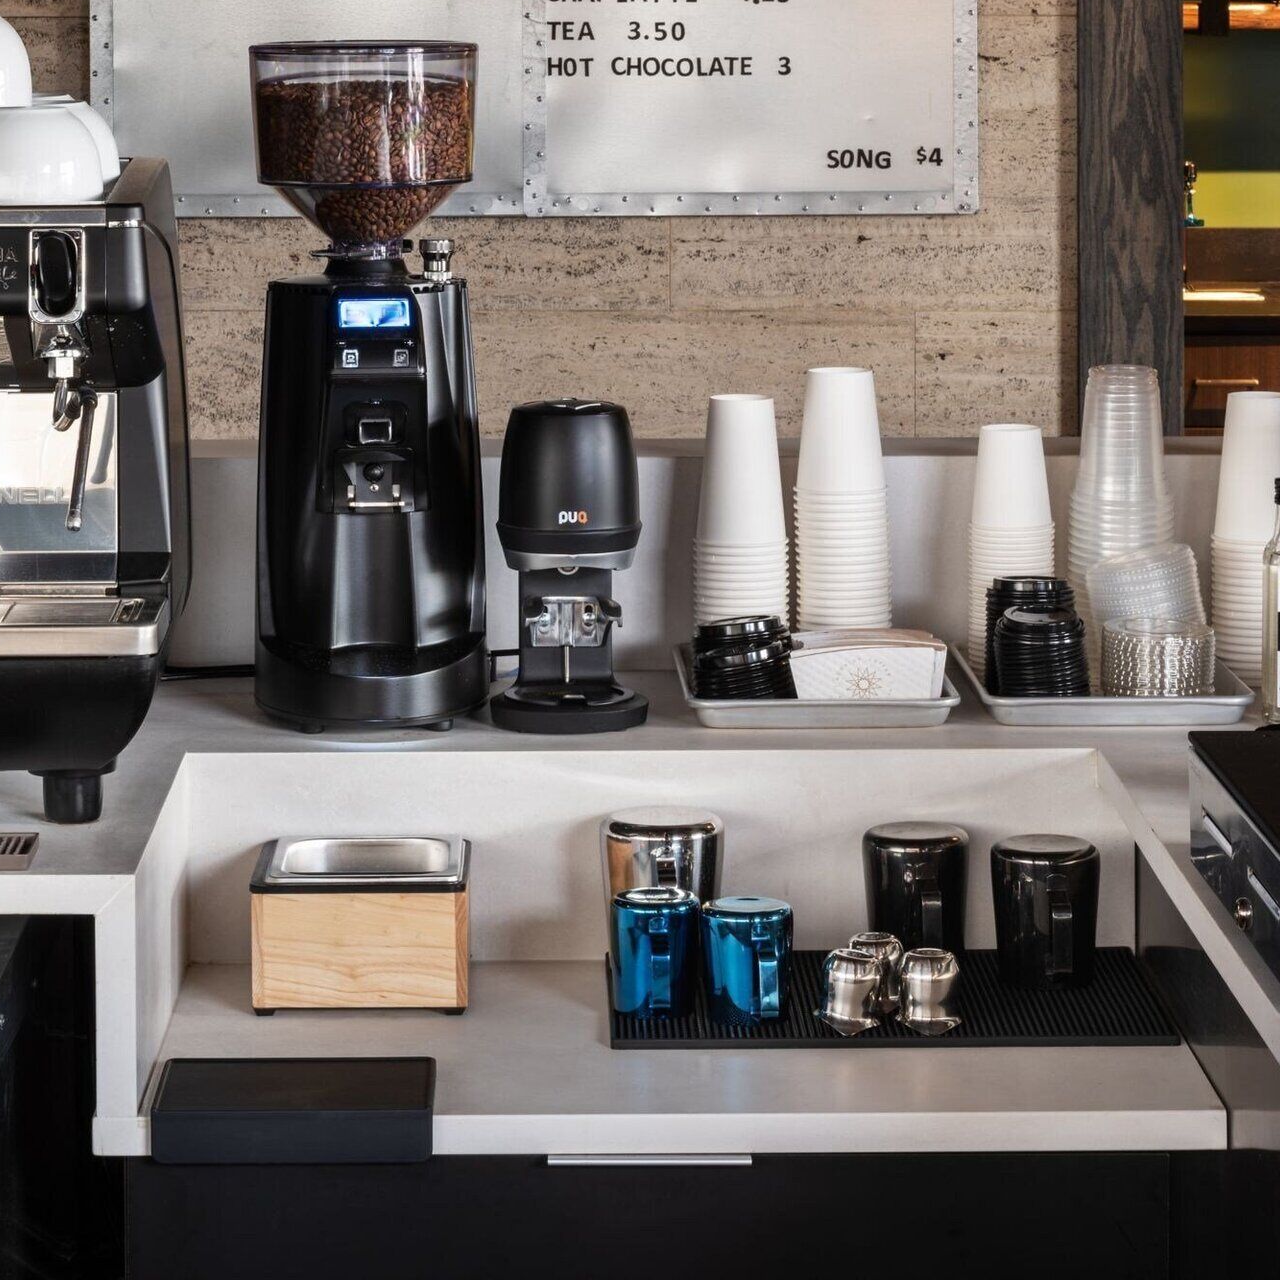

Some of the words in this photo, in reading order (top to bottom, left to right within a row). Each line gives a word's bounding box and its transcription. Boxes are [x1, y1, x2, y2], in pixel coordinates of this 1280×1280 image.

[547, 22, 595, 41] TEA
[627, 21, 686, 42] 3.50
[547, 57, 594, 77] HOT
[610, 57, 753, 77] CHOCOLATE
[777, 57, 792, 76] 3
[826, 149, 892, 170] SONG
[917, 146, 944, 167] $4
